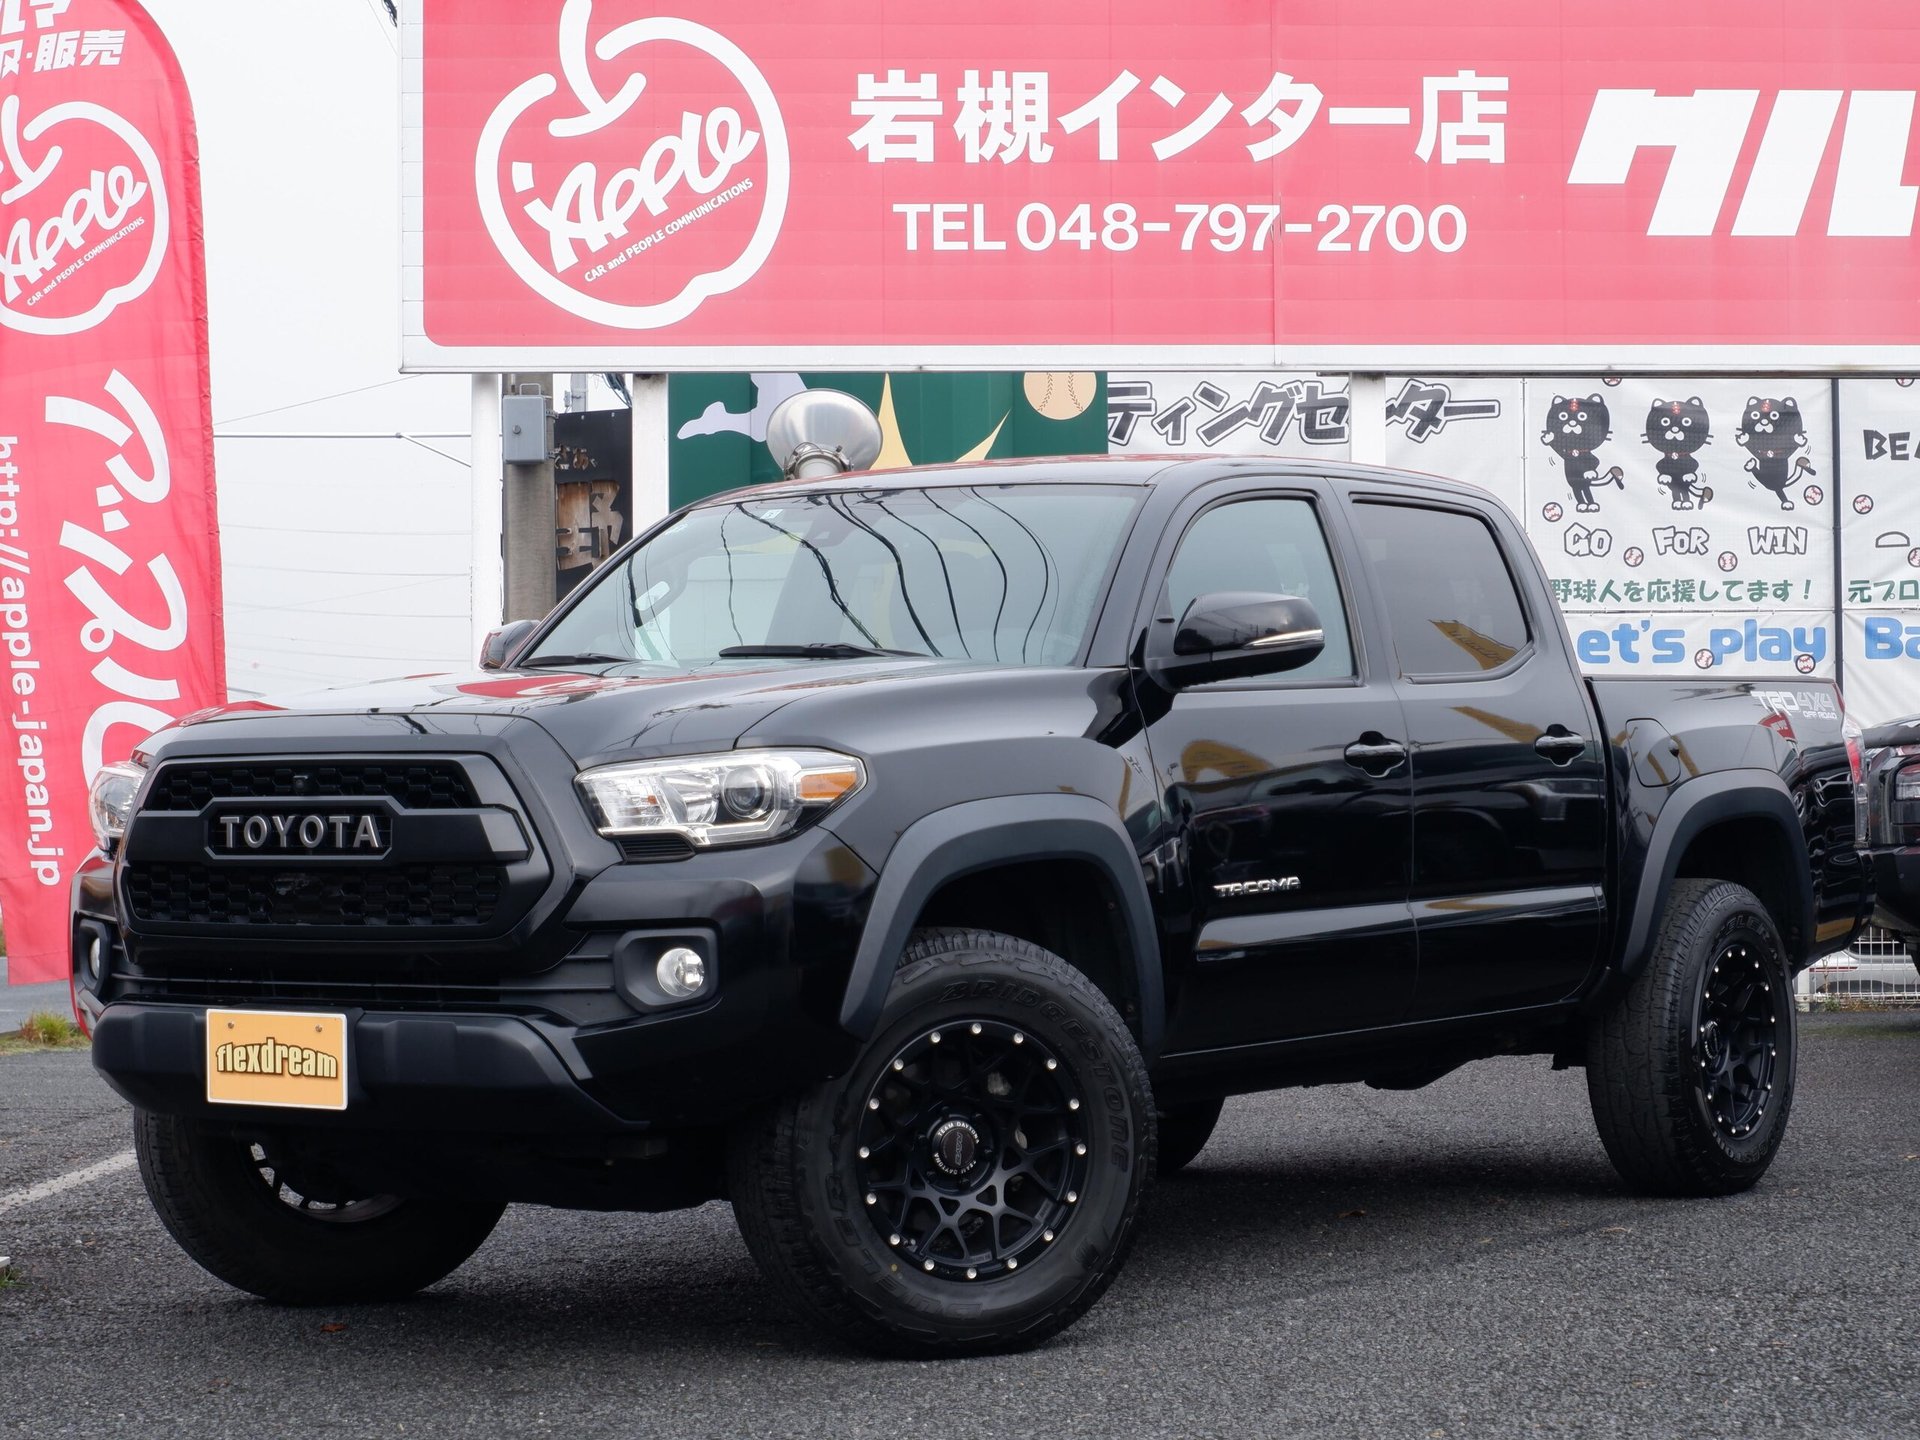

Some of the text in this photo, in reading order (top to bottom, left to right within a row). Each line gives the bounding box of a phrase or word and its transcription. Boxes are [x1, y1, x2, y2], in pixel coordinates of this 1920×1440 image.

[847, 69, 1510, 166] 岩槻インター店
[1567, 88, 1920, 237] クル
[512, 106, 760, 274] Apple
[584, 177, 754, 282] CAR and PEOPLE COMMUNICATIONS
[892, 202, 1468, 253] TEL 048-797-2700
[26, 216, 146, 307] CAR and PEOPLE COMMUNICATIONS
[1107, 379, 1500, 446] ティングセター
[1863, 429, 1920, 461] BE
[1563, 522, 1808, 558] GO FOR WIN
[0, 436, 64, 887] http://apple-japan.jp
[1577, 618, 1828, 666] et's play
[1750, 691, 1800, 717] TRD
[218, 814, 383, 849] TOYOTA
[1213, 876, 1303, 898] TACOMA
[215, 1036, 339, 1080] flexdream
[937, 1121, 980, 1144] TEAM DAYTONA
[933, 1152, 958, 1176] DAYTONA
